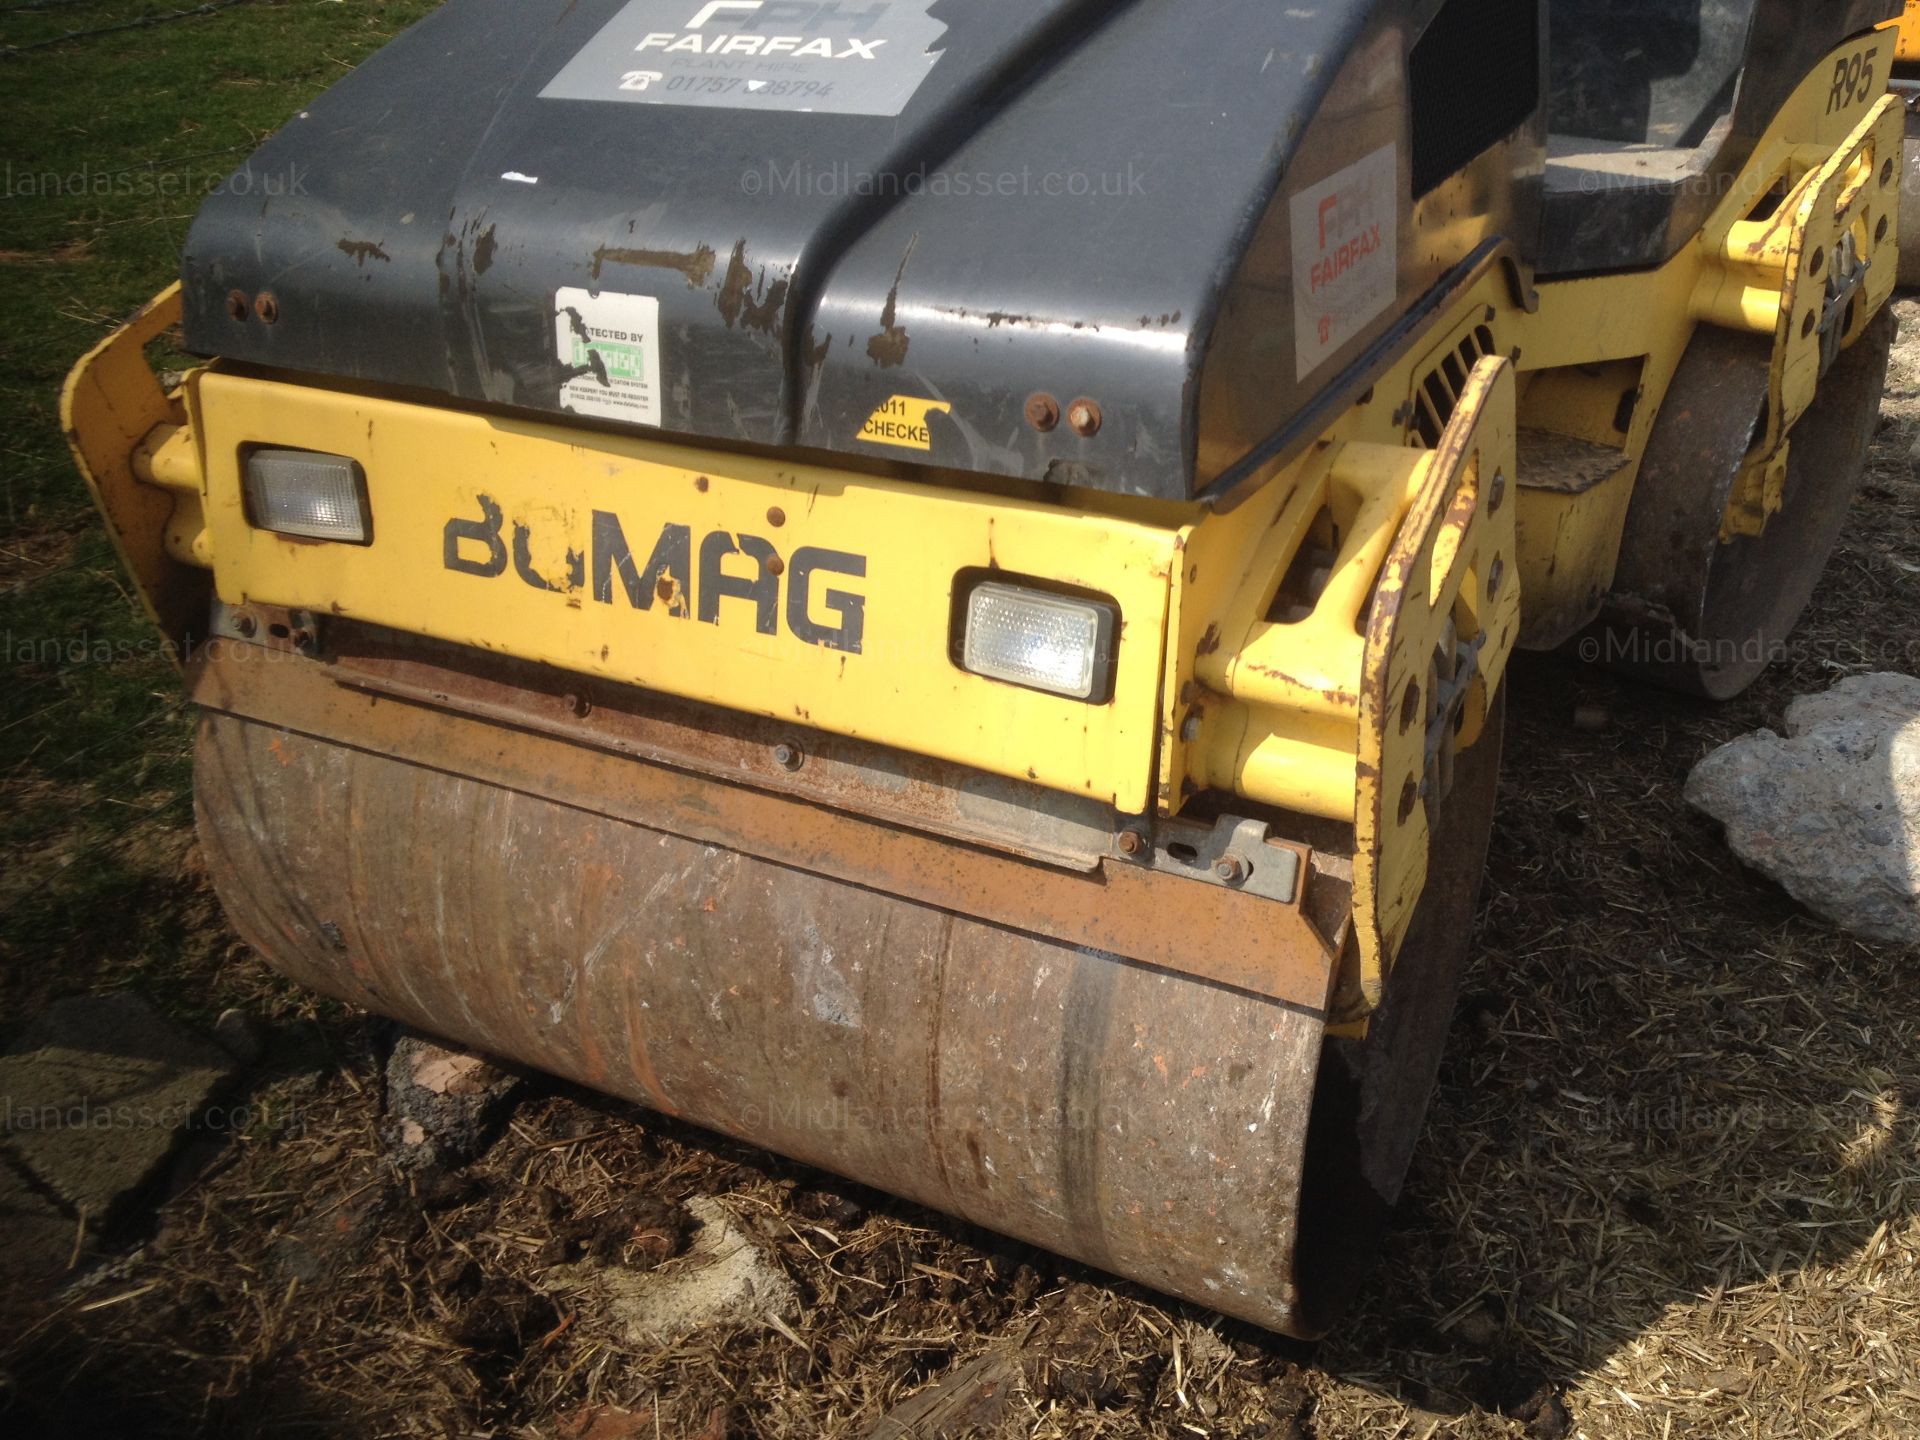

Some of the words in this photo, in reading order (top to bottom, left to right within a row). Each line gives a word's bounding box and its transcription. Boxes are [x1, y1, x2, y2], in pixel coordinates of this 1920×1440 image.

[634, 33, 888, 59] FAIRFAX
[670, 59, 750, 72] PLANT
[666, 76, 742, 93] 01757
[1826, 47, 1878, 115] R95
[1311, 224, 1381, 294] FAIRFAX
[631, 332, 643, 342] BY
